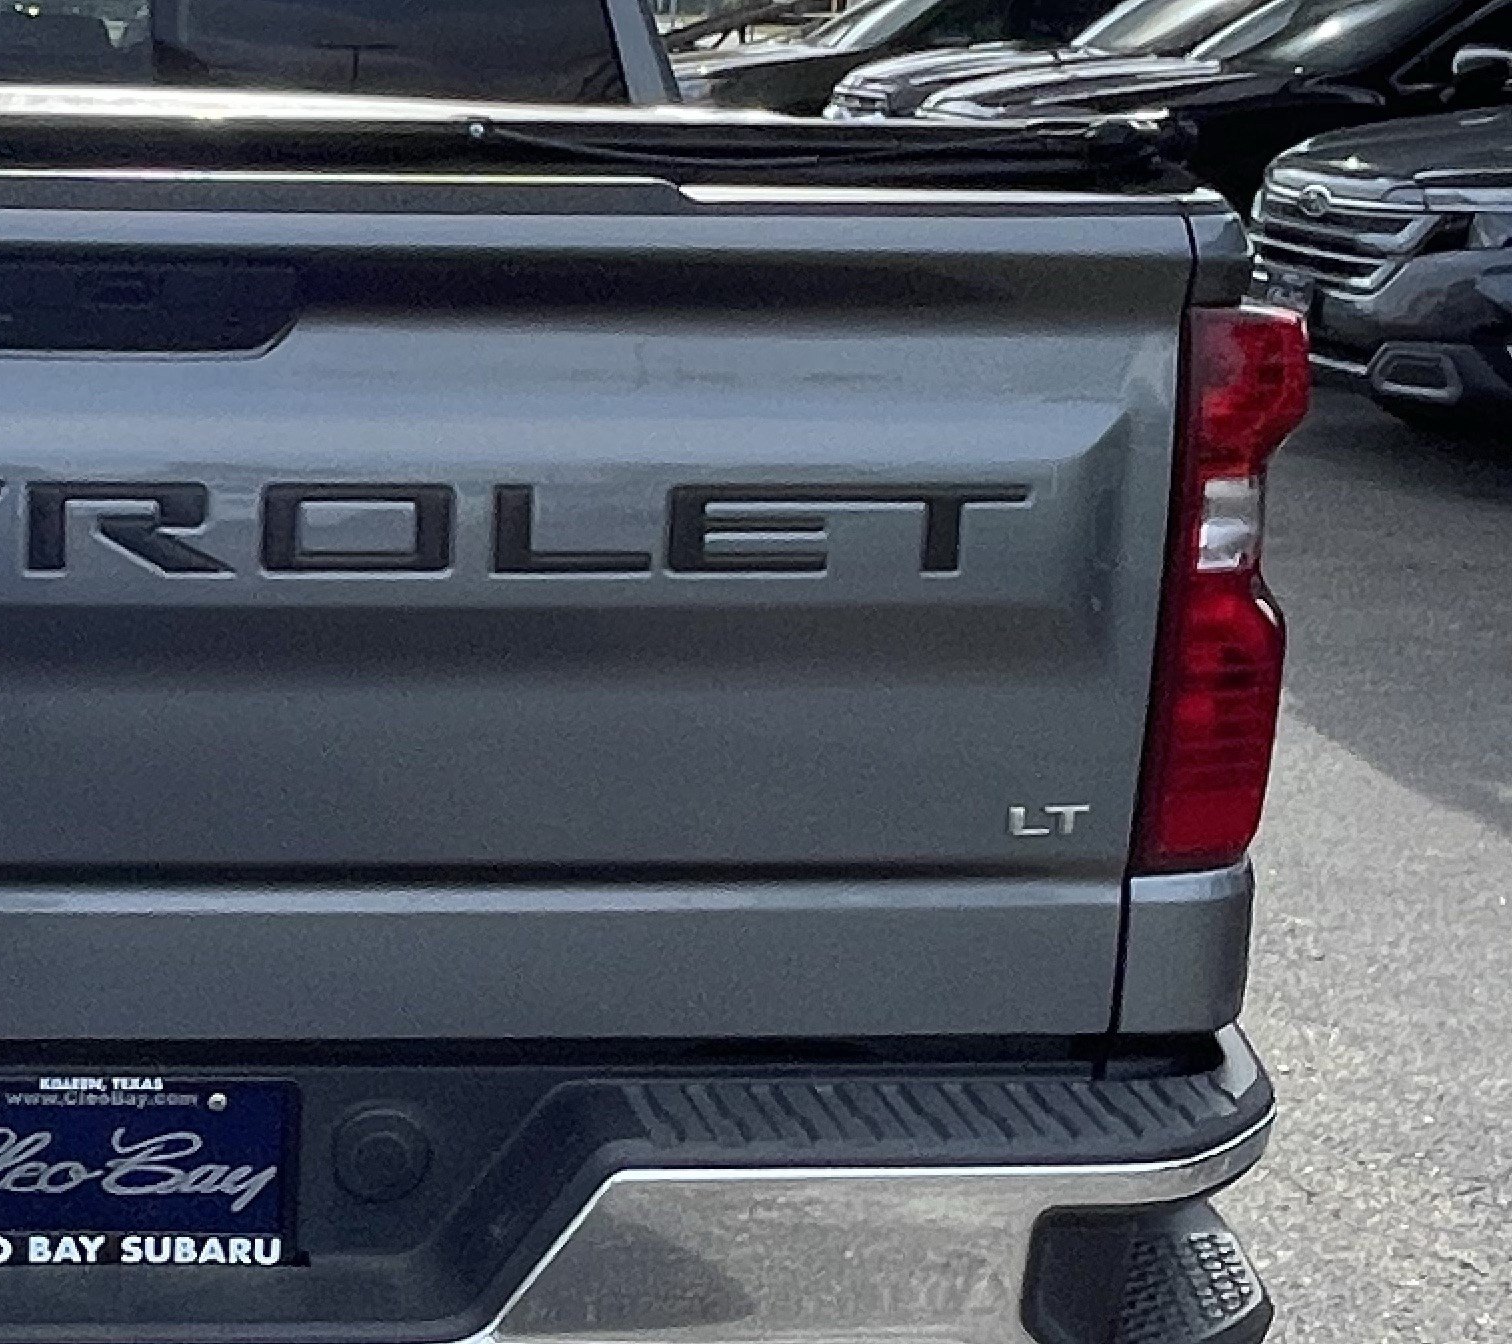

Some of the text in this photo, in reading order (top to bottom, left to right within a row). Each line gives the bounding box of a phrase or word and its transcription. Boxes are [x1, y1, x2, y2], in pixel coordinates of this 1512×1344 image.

[1007, 804, 1090, 836] LT
[111, 1076, 164, 1091] TEXAS
[4, 1090, 199, 1109] www.CleoBay.com
[100, 1126, 278, 1212] Bay
[28, 1236, 105, 1263] BAY
[120, 1235, 282, 1265] SUBARU
